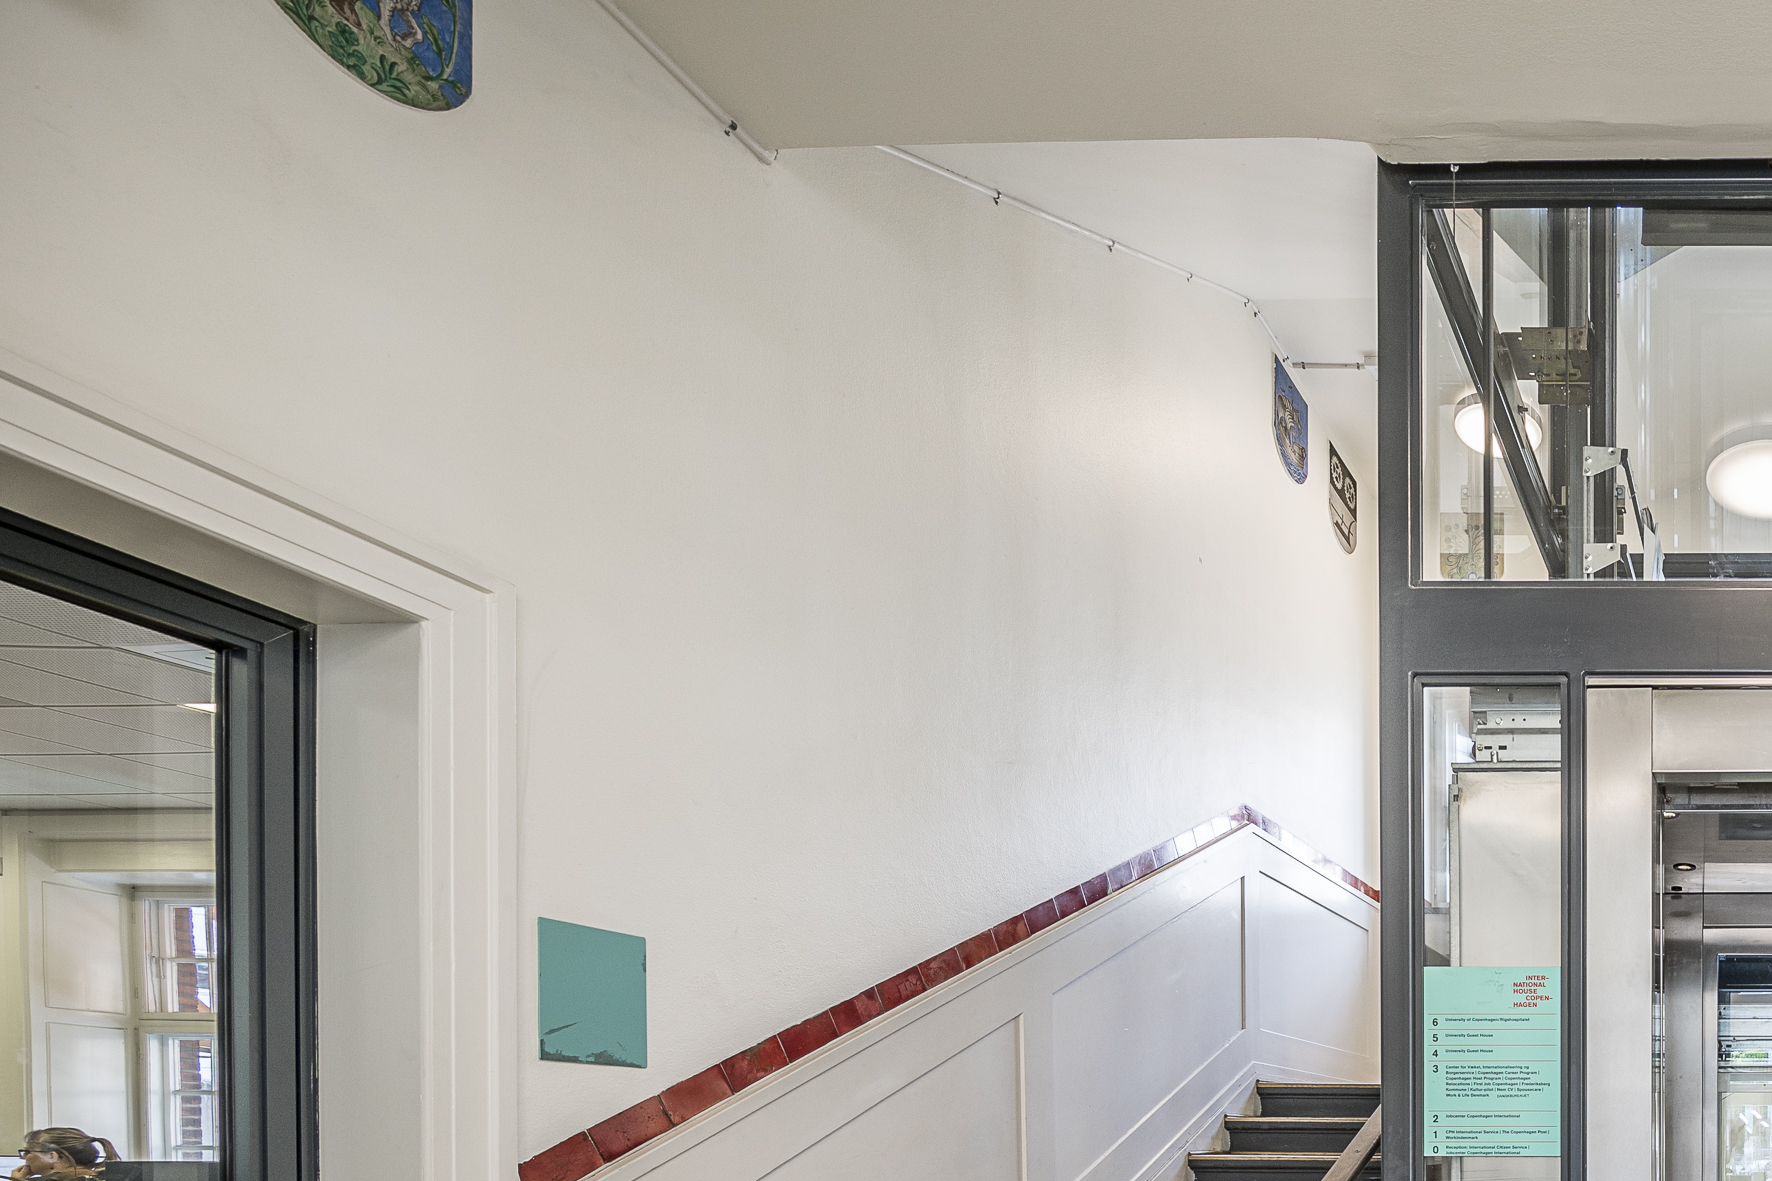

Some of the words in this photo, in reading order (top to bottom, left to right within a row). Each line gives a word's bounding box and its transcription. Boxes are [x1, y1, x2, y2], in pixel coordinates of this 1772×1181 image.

[1432, 1018, 1438, 1026] 6
[1432, 1034, 1438, 1042] 5
[1432, 1065, 1438, 1073] 3
